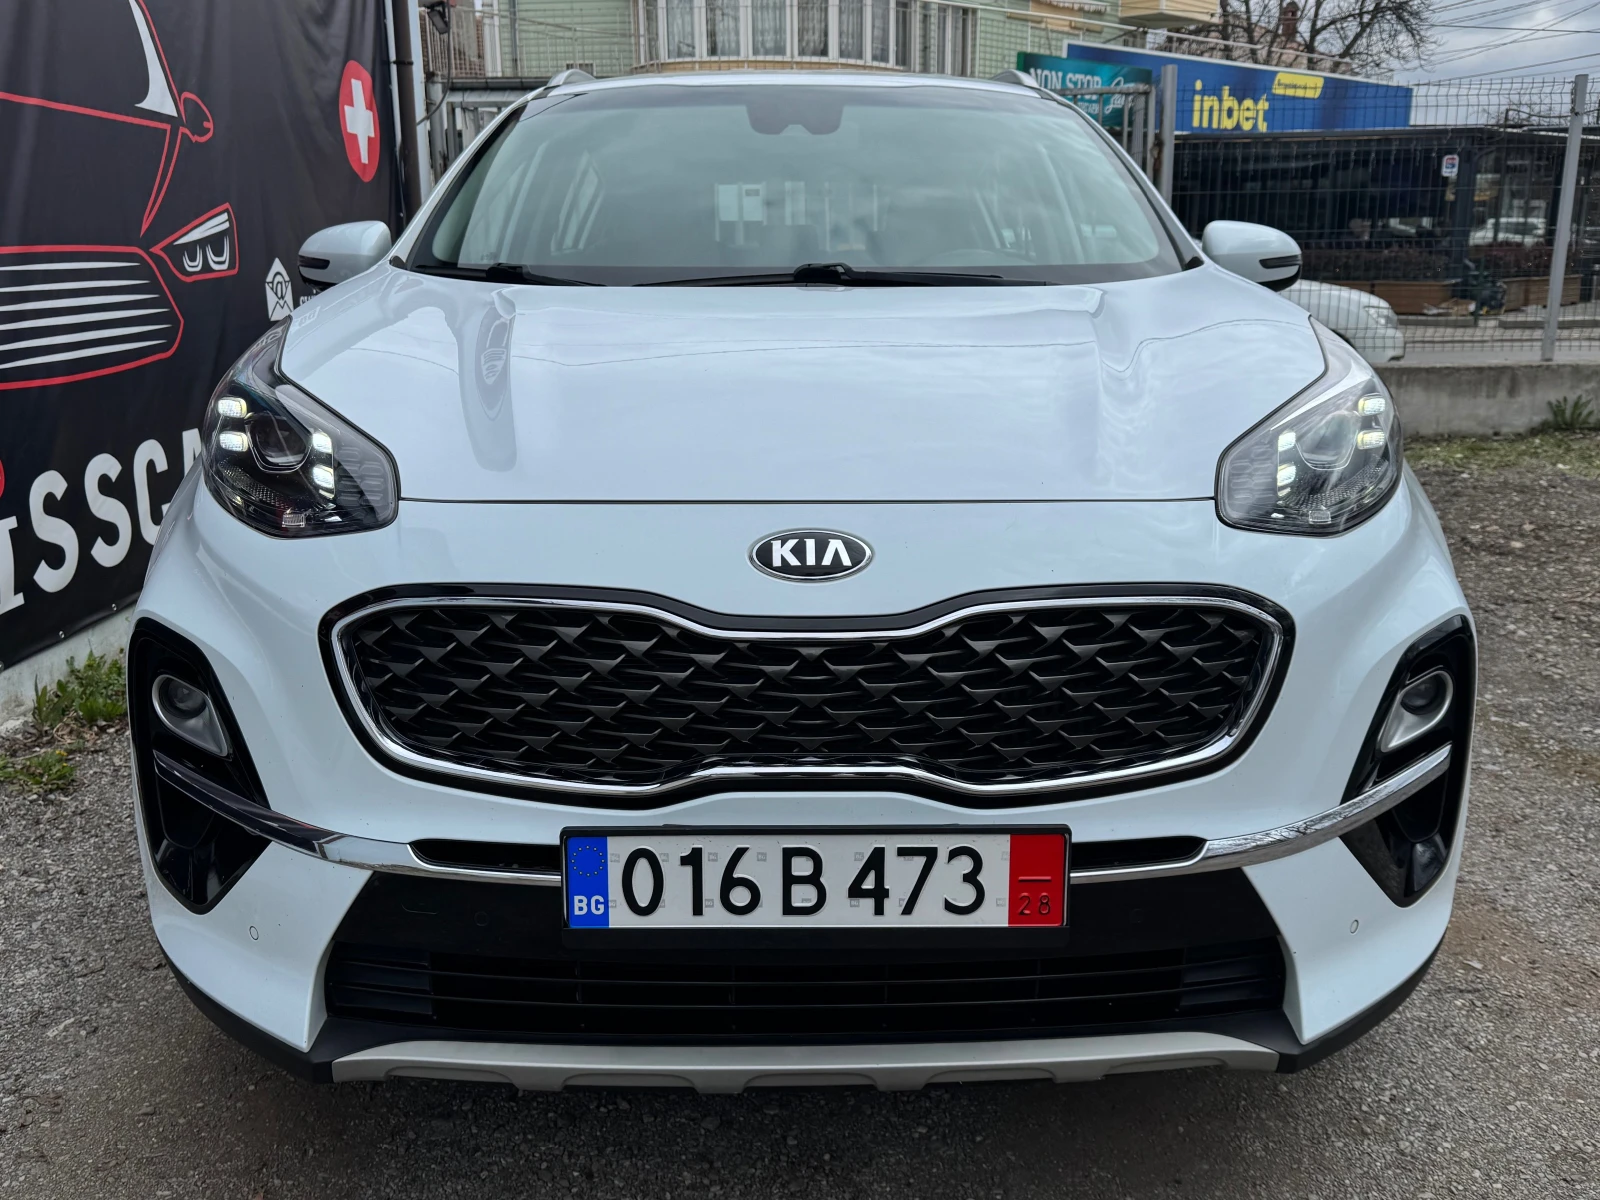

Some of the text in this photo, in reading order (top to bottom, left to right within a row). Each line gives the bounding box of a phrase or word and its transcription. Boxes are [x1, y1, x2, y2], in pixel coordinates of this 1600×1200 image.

[1029, 67, 1063, 91] NON
[1066, 73, 1102, 100] STOP
[1192, 79, 1269, 133] inbet
[0, 427, 202, 615] ISSC
[770, 538, 852, 567] KIA
[621, 845, 985, 916] 016 B 473
[573, 894, 605, 915] BG
[1017, 891, 1051, 915] 28
